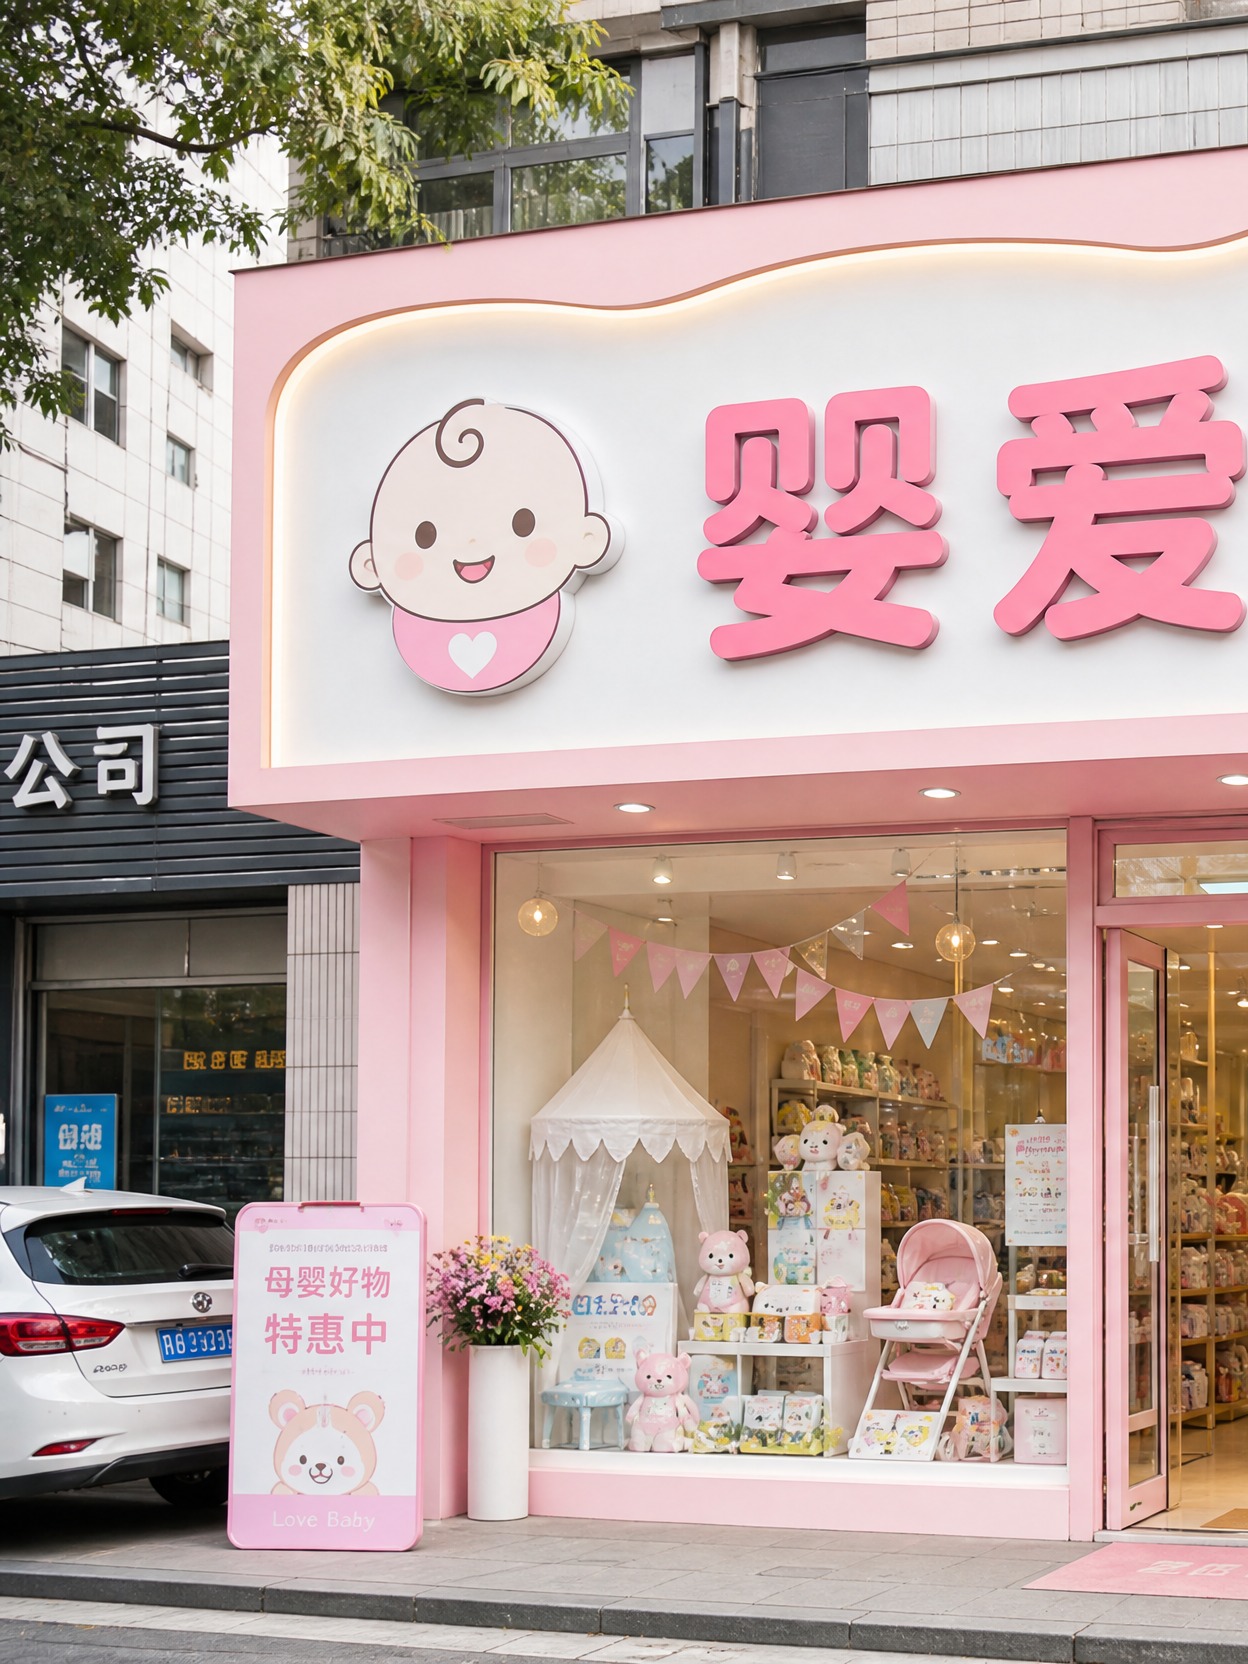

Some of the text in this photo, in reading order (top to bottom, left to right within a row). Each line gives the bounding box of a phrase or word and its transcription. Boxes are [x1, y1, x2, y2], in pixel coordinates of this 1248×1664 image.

[4, 723, 162, 809] 公司
[264, 1265, 391, 1299] 母婴好物
[264, 1313, 387, 1355] 特惠中
[272, 1510, 376, 1533] Love Baby
